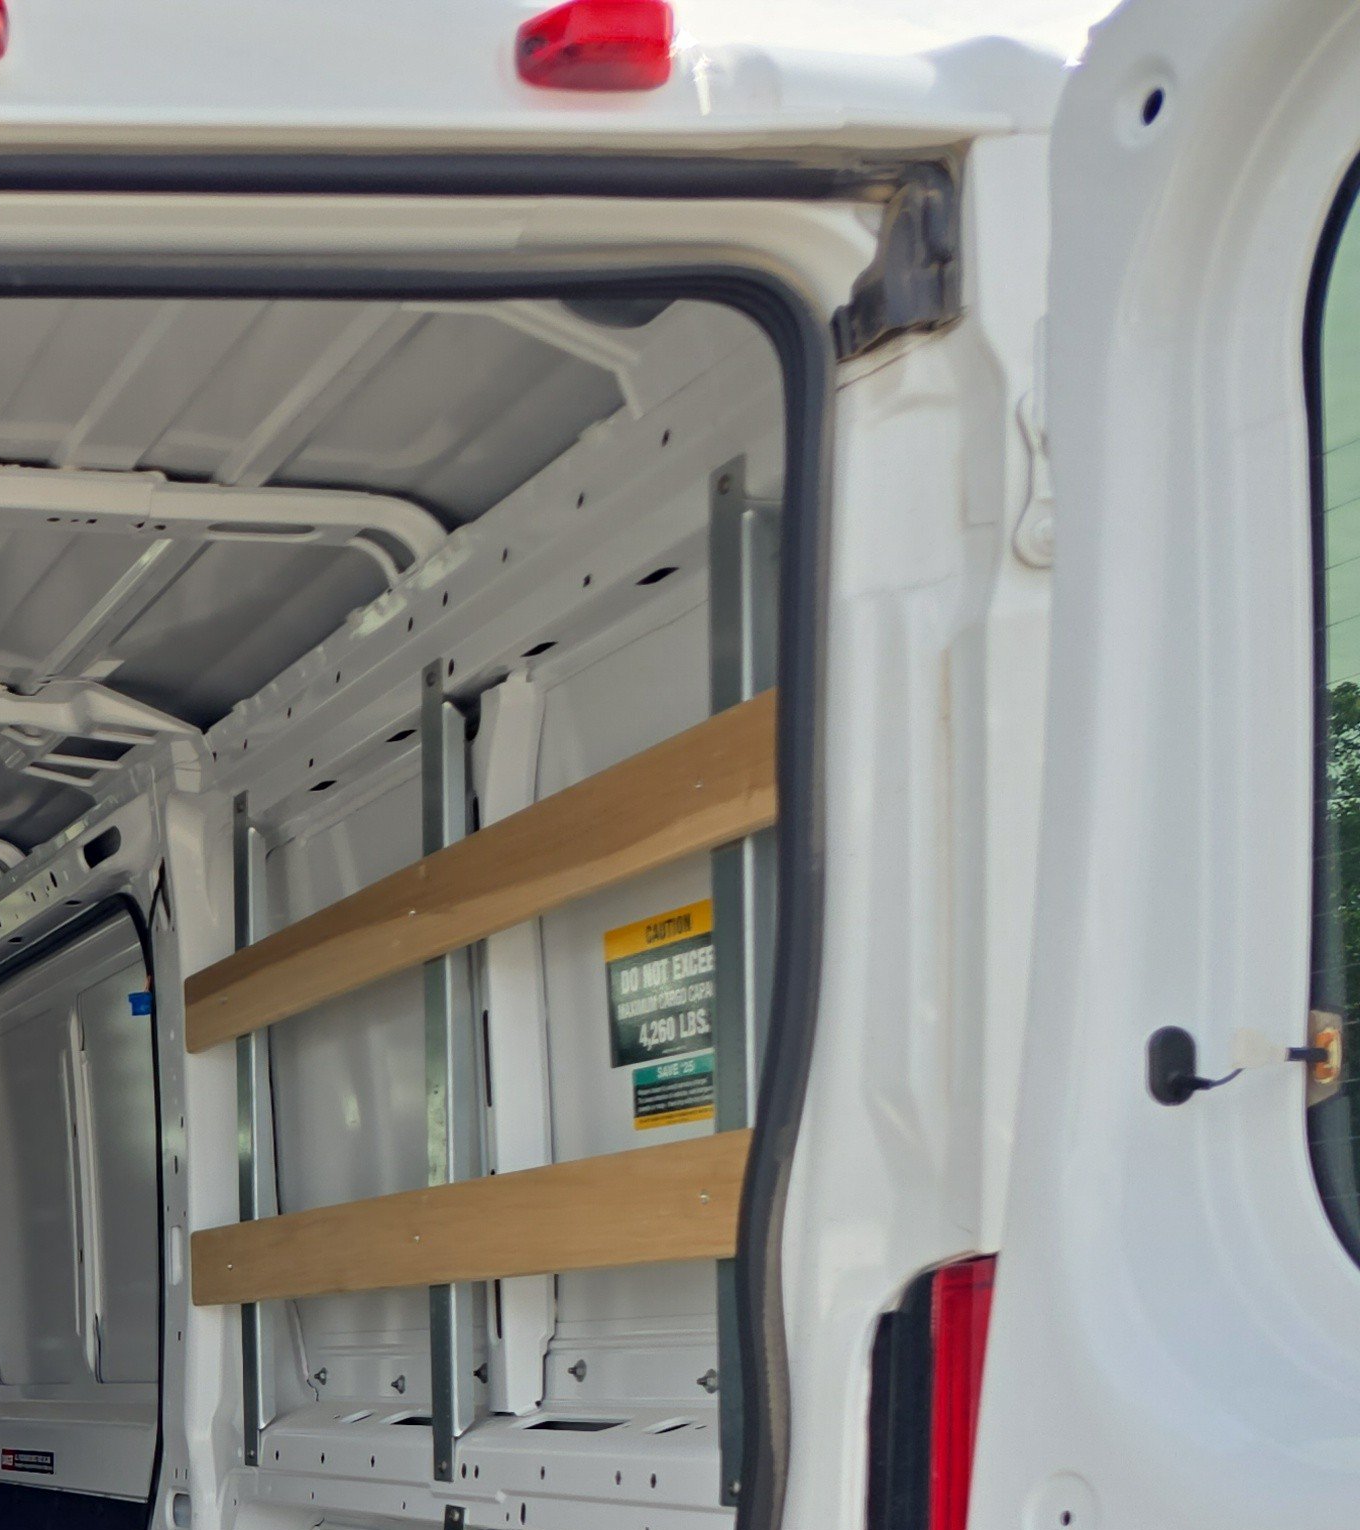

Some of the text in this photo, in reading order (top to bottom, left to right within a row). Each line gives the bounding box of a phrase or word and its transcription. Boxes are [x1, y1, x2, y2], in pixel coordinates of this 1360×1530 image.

[645, 912, 691, 944] CAUTION
[621, 944, 715, 995] DO NOT EXCEE
[617, 980, 715, 1021] MAXIMUM CARGO CAPA
[639, 1008, 711, 1051] 4,260 LBS.
[657, 1062, 679, 1079] SAVE
